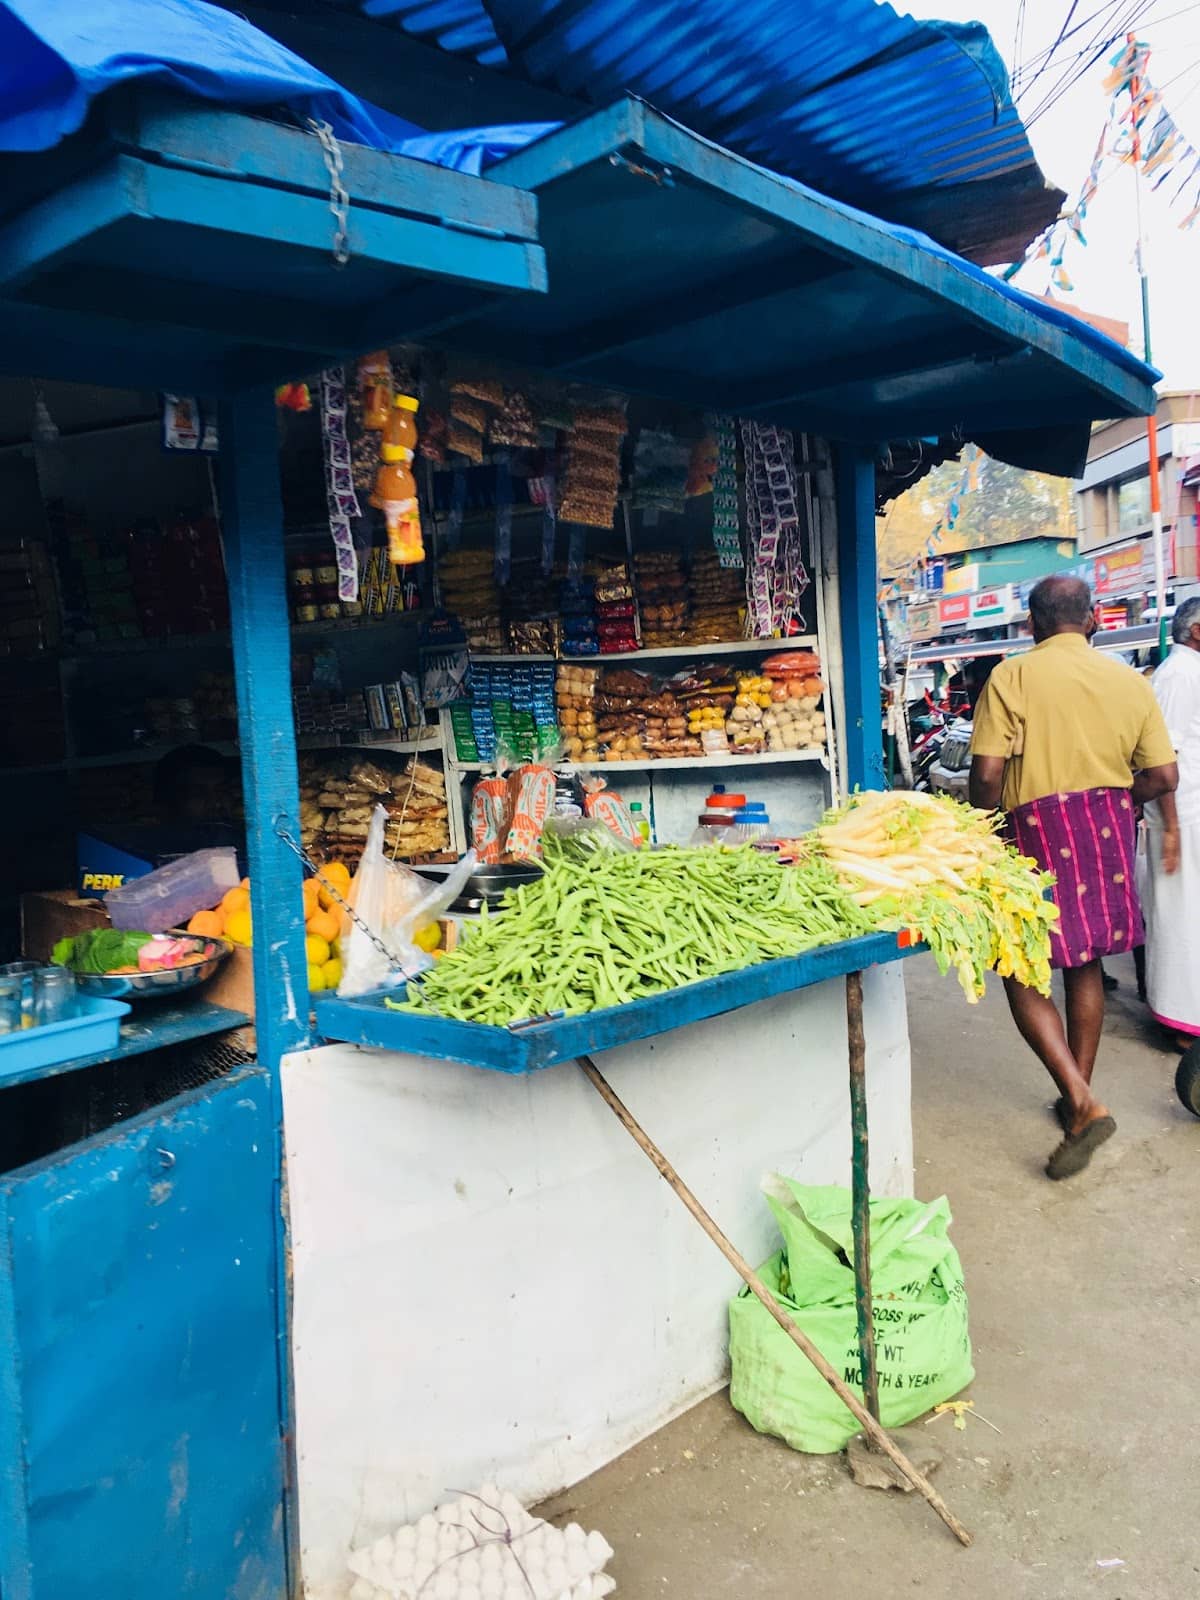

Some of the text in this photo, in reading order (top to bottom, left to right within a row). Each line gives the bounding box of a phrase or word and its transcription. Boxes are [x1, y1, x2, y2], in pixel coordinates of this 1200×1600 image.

[82, 873, 125, 890] PERK
[871, 1306, 903, 1323] ROSS
[843, 1366, 892, 1389] MOTH
[894, 1373, 903, 1389] &
